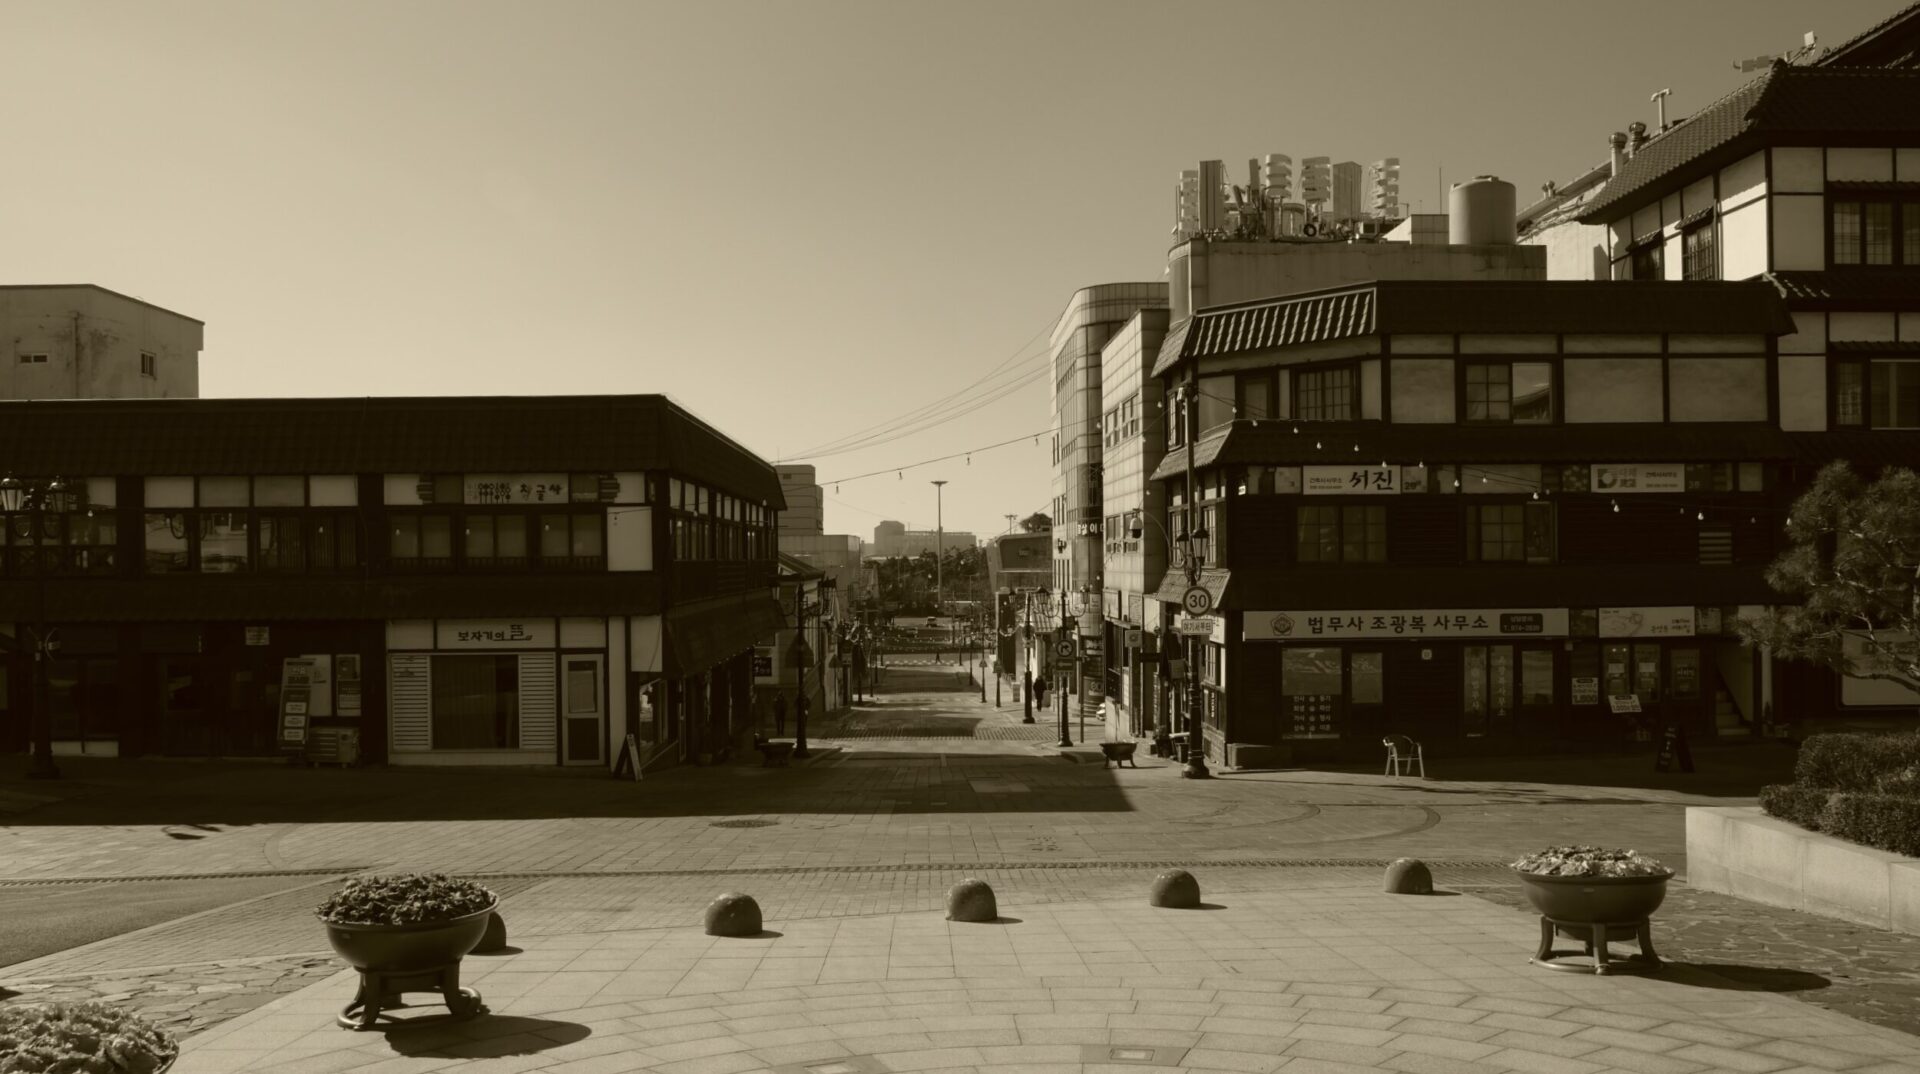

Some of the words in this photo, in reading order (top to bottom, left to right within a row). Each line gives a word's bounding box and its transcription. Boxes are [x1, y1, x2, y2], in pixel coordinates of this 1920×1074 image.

[1349, 469, 1394, 491] 서진
[1189, 594, 1207, 608] 30
[457, 631, 505, 642] 보자기의
[510, 623, 524, 641] 뜰
[1183, 621, 1211, 632] 여기서부터
[1308, 615, 1364, 634] 법무사
[1371, 615, 1426, 634] 조광복
[1433, 614, 1489, 631] 사무소
